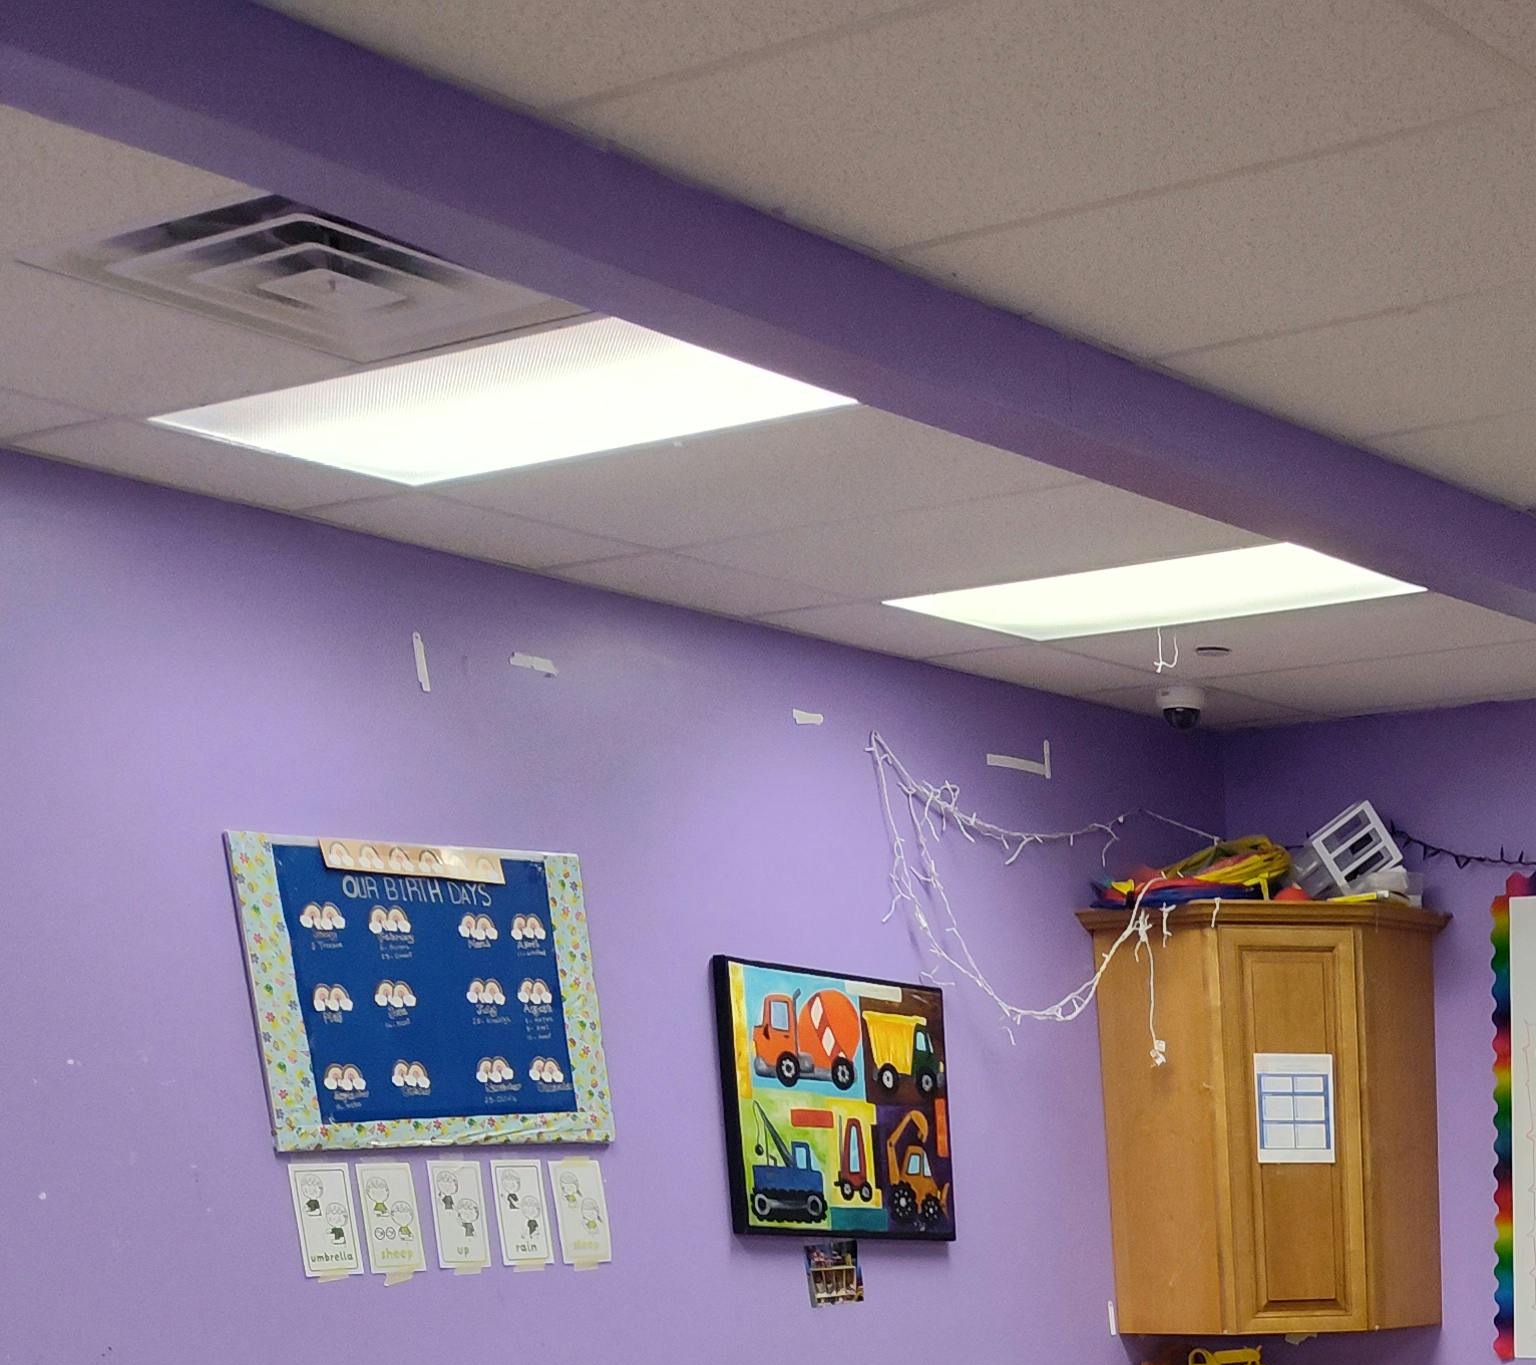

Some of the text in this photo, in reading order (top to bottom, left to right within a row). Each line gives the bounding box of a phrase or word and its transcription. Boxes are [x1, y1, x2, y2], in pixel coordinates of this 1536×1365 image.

[342, 875, 492, 907] OUR BIRTH DAYS
[457, 1246, 469, 1258] up
[516, 1241, 537, 1252] rain
[311, 1251, 353, 1263] umbrella
